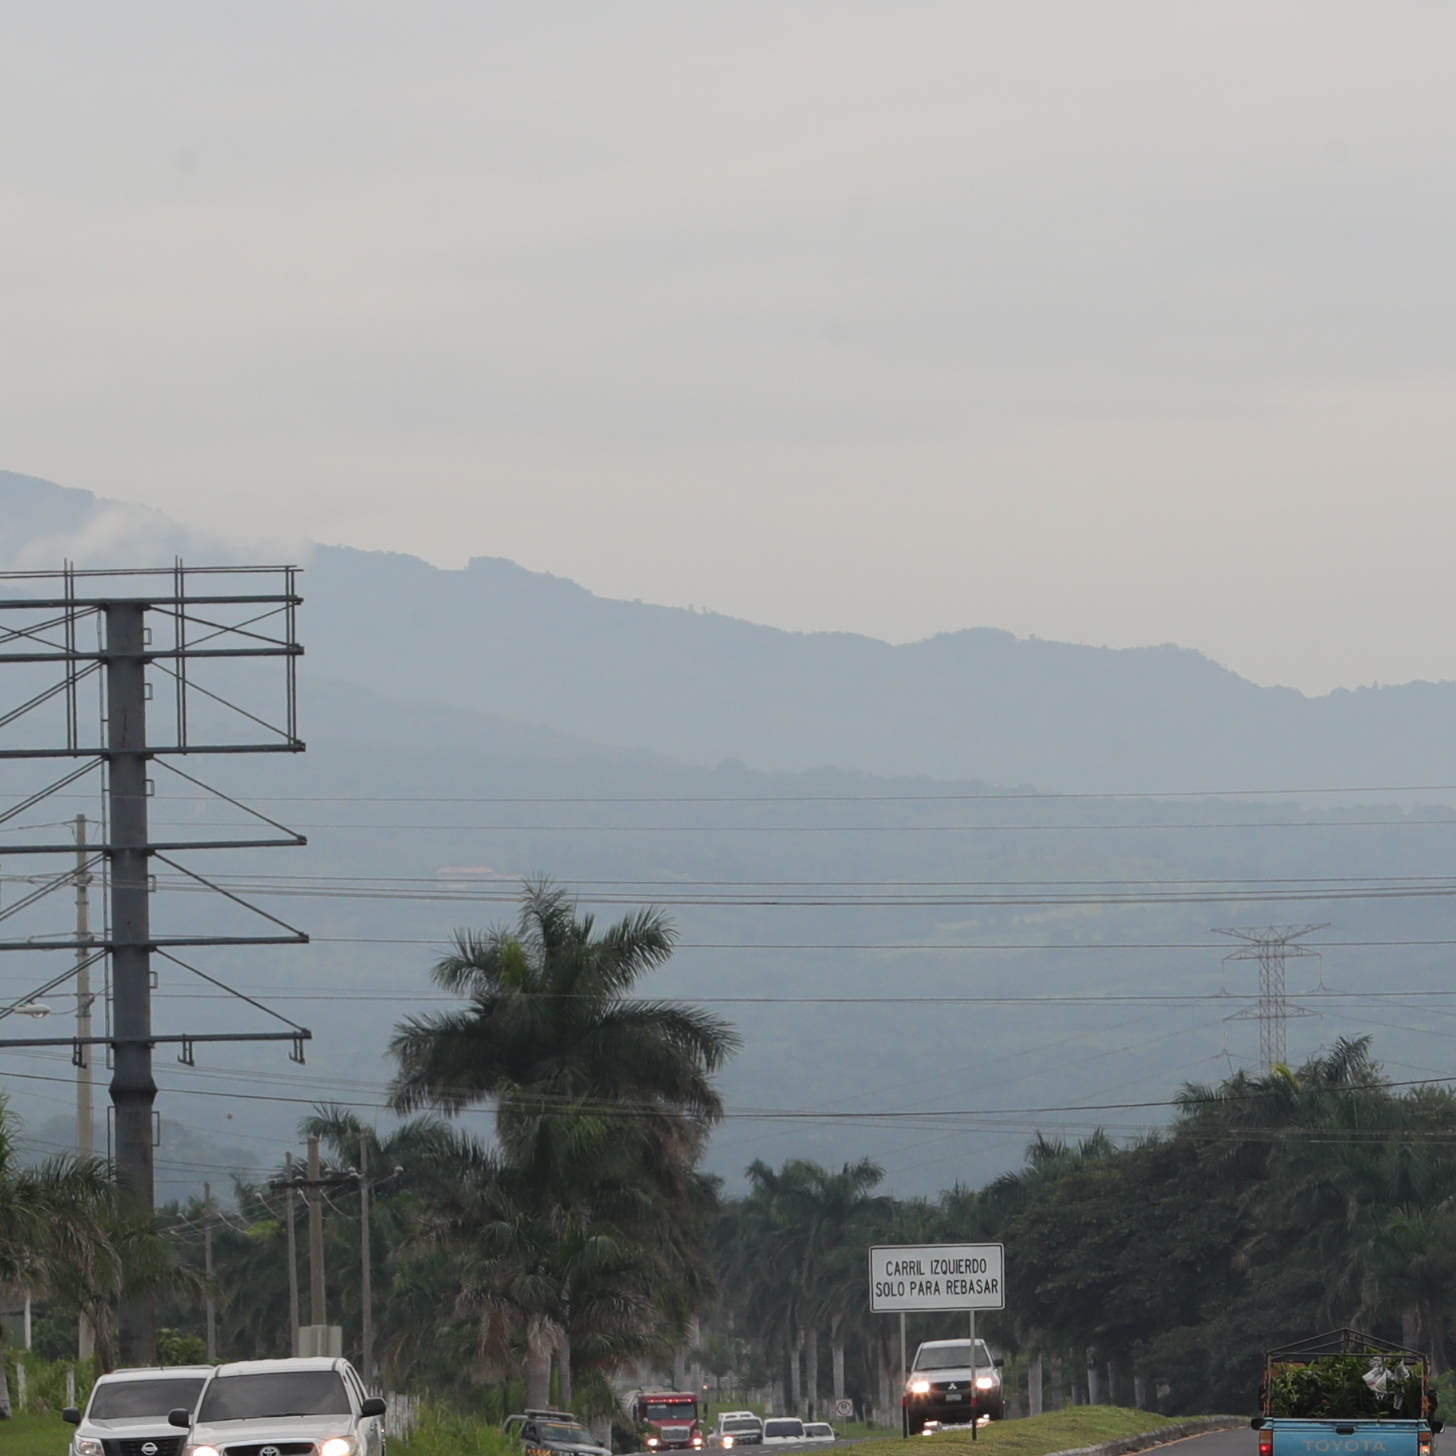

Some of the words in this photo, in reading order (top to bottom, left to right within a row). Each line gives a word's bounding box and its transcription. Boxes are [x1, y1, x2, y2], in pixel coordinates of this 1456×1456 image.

[885, 1260, 925, 1277] CARRIL
[930, 1258, 987, 1275] IZQUIERDO
[875, 1281, 905, 1298] SOLO
[910, 1280, 941, 1296] PARA
[946, 1278, 999, 1295] REBASAR
[1302, 1439, 1387, 1453] TOYOTA
